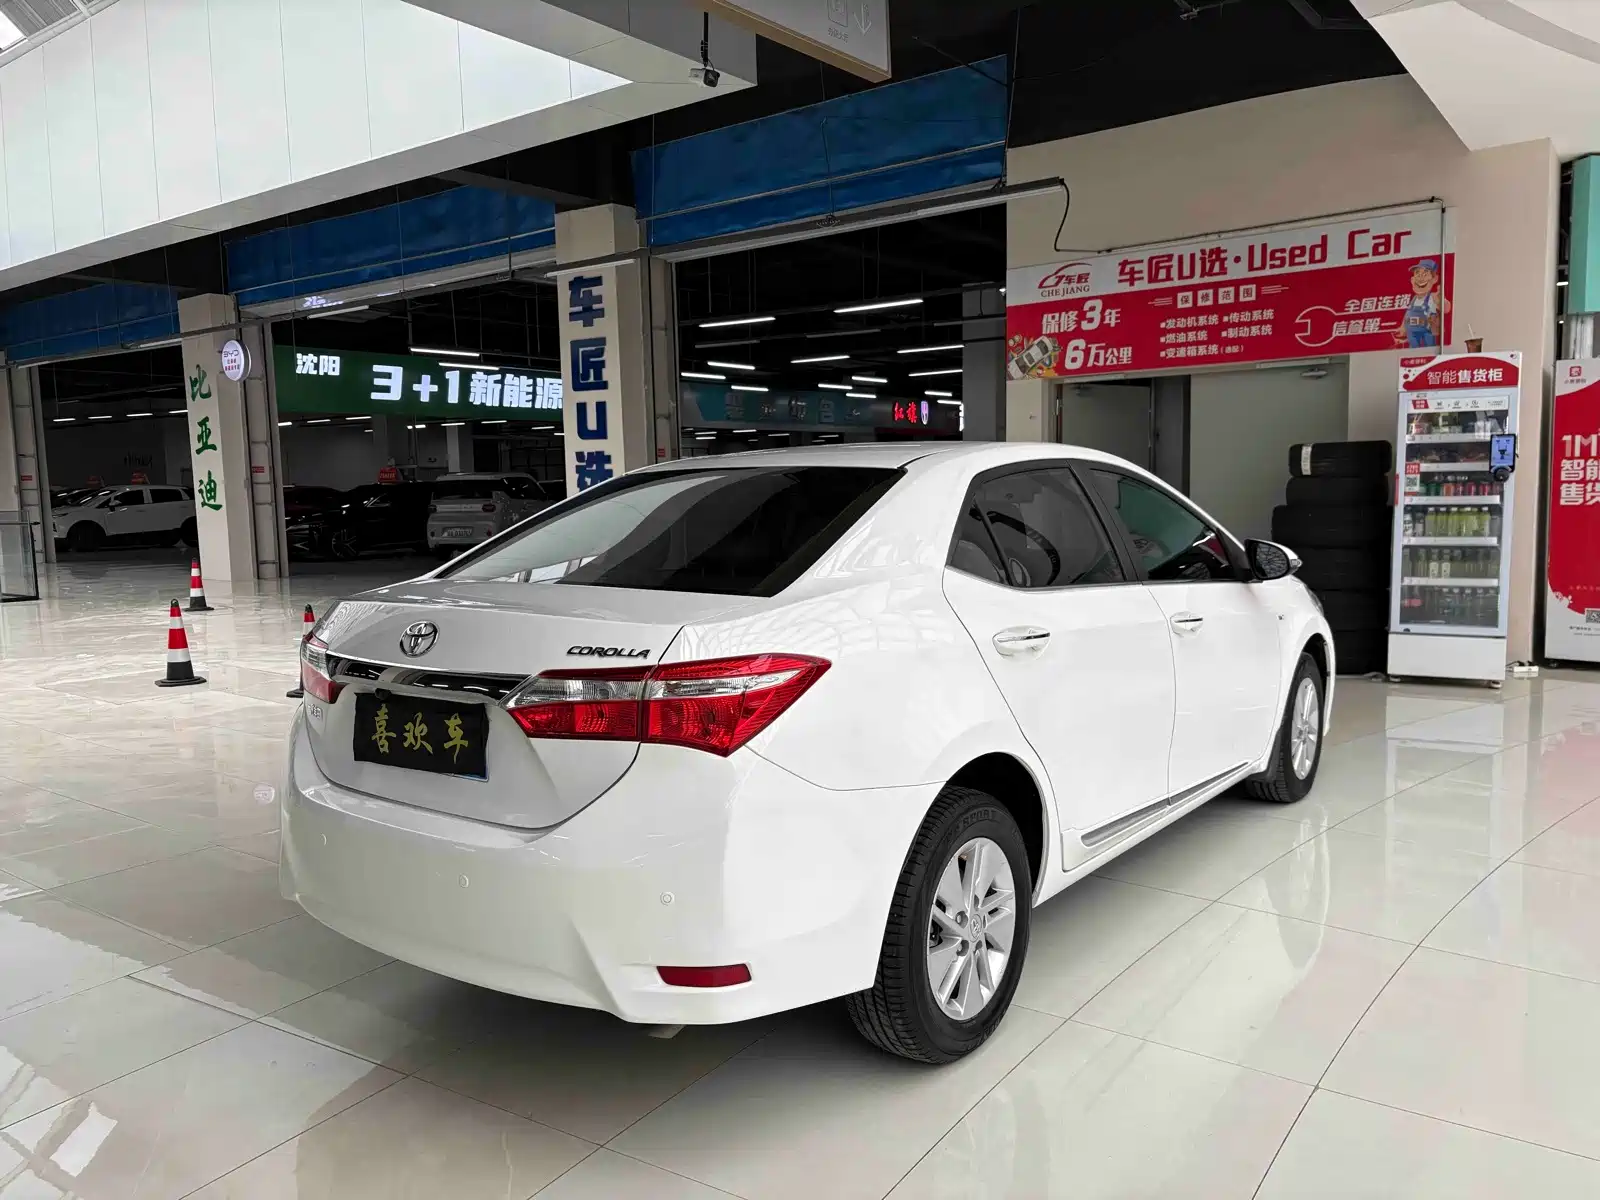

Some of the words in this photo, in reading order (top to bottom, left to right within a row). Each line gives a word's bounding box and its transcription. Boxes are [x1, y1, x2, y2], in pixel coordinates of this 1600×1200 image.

[1347, 228, 1412, 260] Car
[1041, 299, 1121, 335] 保修3年
[1344, 293, 1412, 313] 全国连锁
[1165, 314, 1219, 329] 发动机系统
[1229, 309, 1274, 323] 传动系统
[1227, 324, 1273, 338] 制动系统
[296, 353, 341, 377] 沈阳
[1064, 338, 1133, 370] 6万公里
[568, 276, 614, 493] 车匠U选
[1427, 368, 1504, 385] 智能售货柜
[189, 363, 223, 512] 比亚迪
[566, 645, 651, 659] COROLLA
[371, 703, 469, 765] 喜欢车
